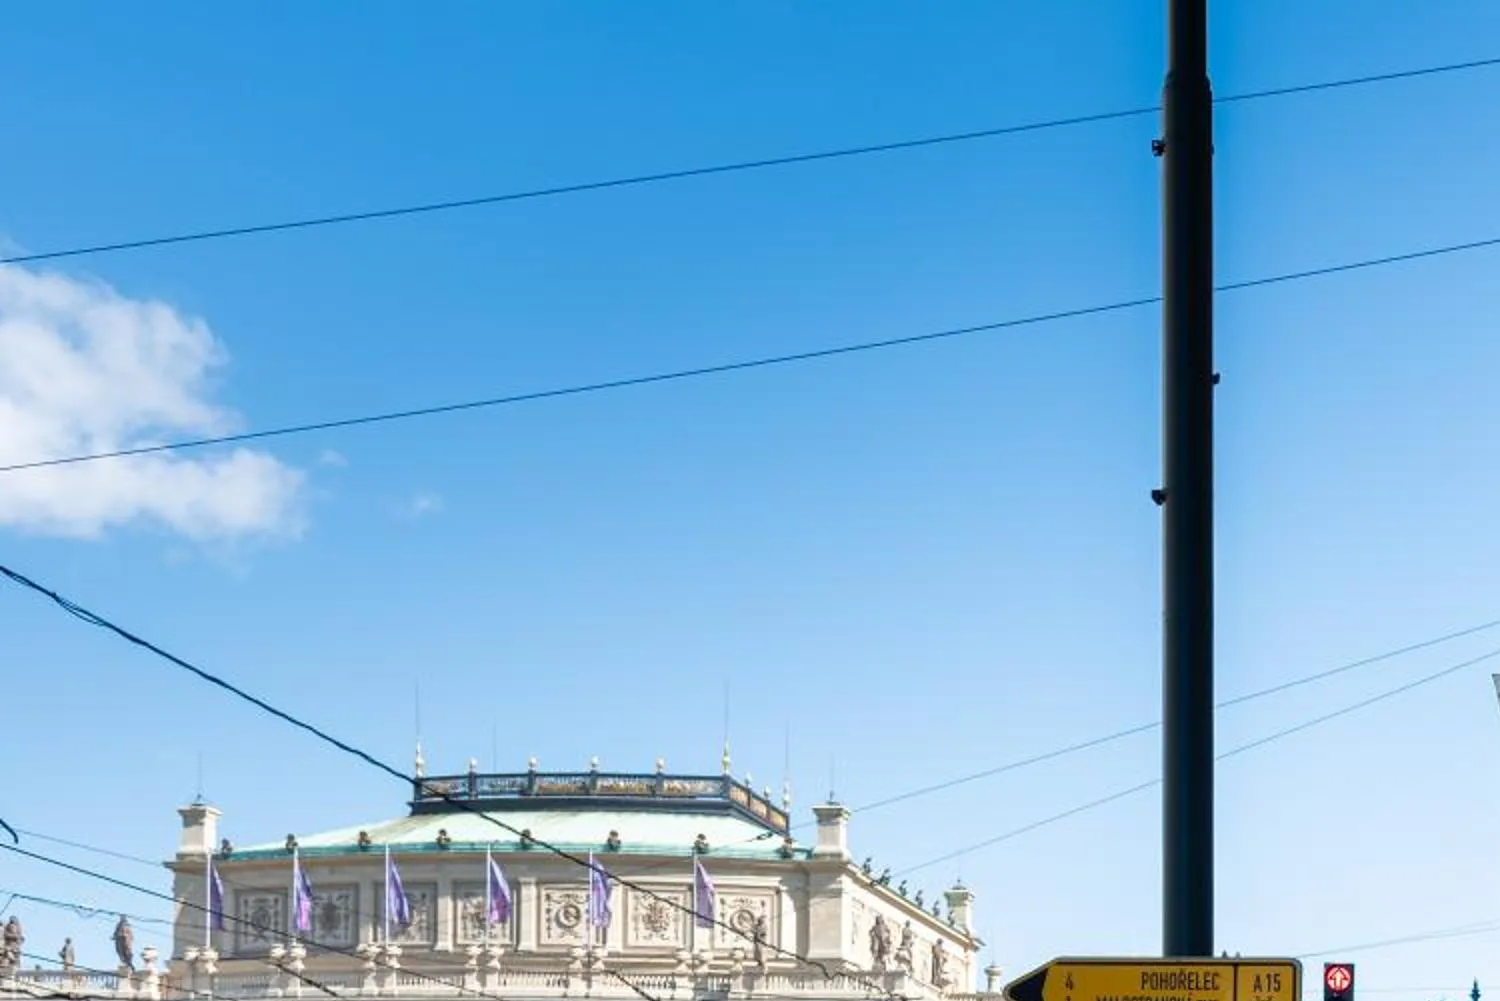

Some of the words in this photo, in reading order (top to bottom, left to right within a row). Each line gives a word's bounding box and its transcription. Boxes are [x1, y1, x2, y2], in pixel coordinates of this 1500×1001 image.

[1140, 970, 1221, 991] POHOŘELEC
[1253, 974, 1263, 993] A
[1265, 973, 1281, 993] 15
